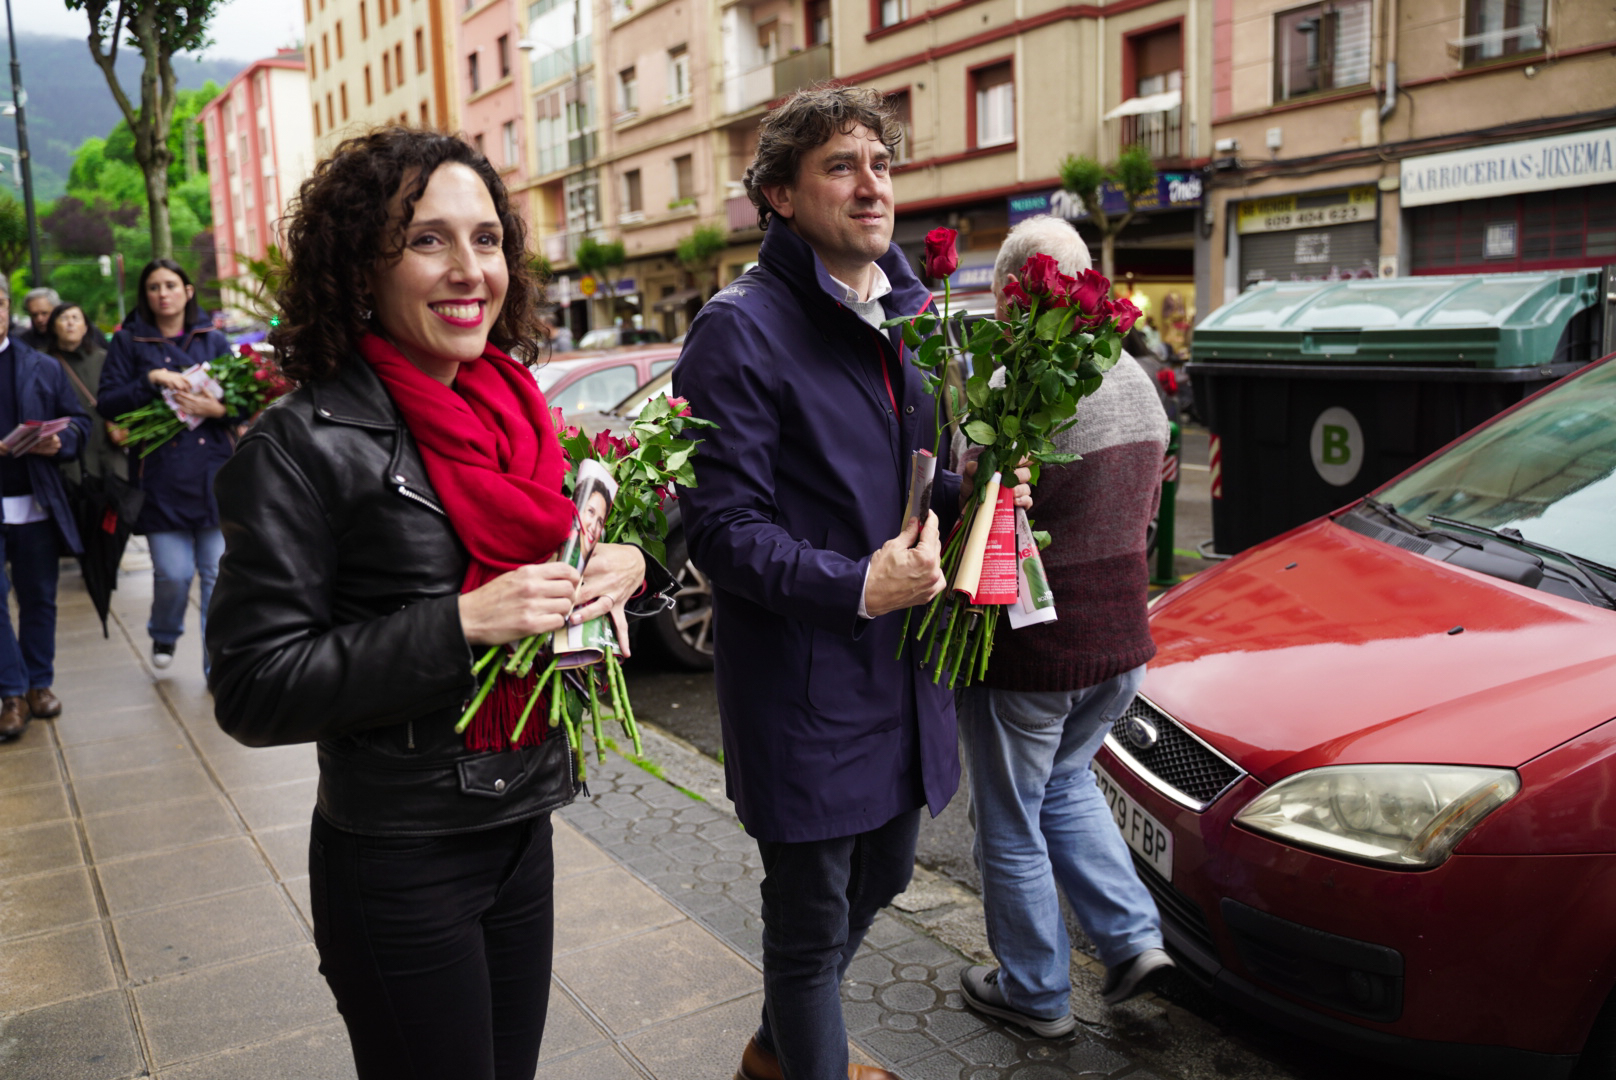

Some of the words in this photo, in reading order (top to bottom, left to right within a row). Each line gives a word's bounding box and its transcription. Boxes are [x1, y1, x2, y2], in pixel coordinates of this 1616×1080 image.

[1402, 153, 1532, 194] CARROCERIAS
[1537, 139, 1616, 180] JOSEMA
[1321, 424, 1352, 466] B
[1131, 807, 1166, 864] FBP
